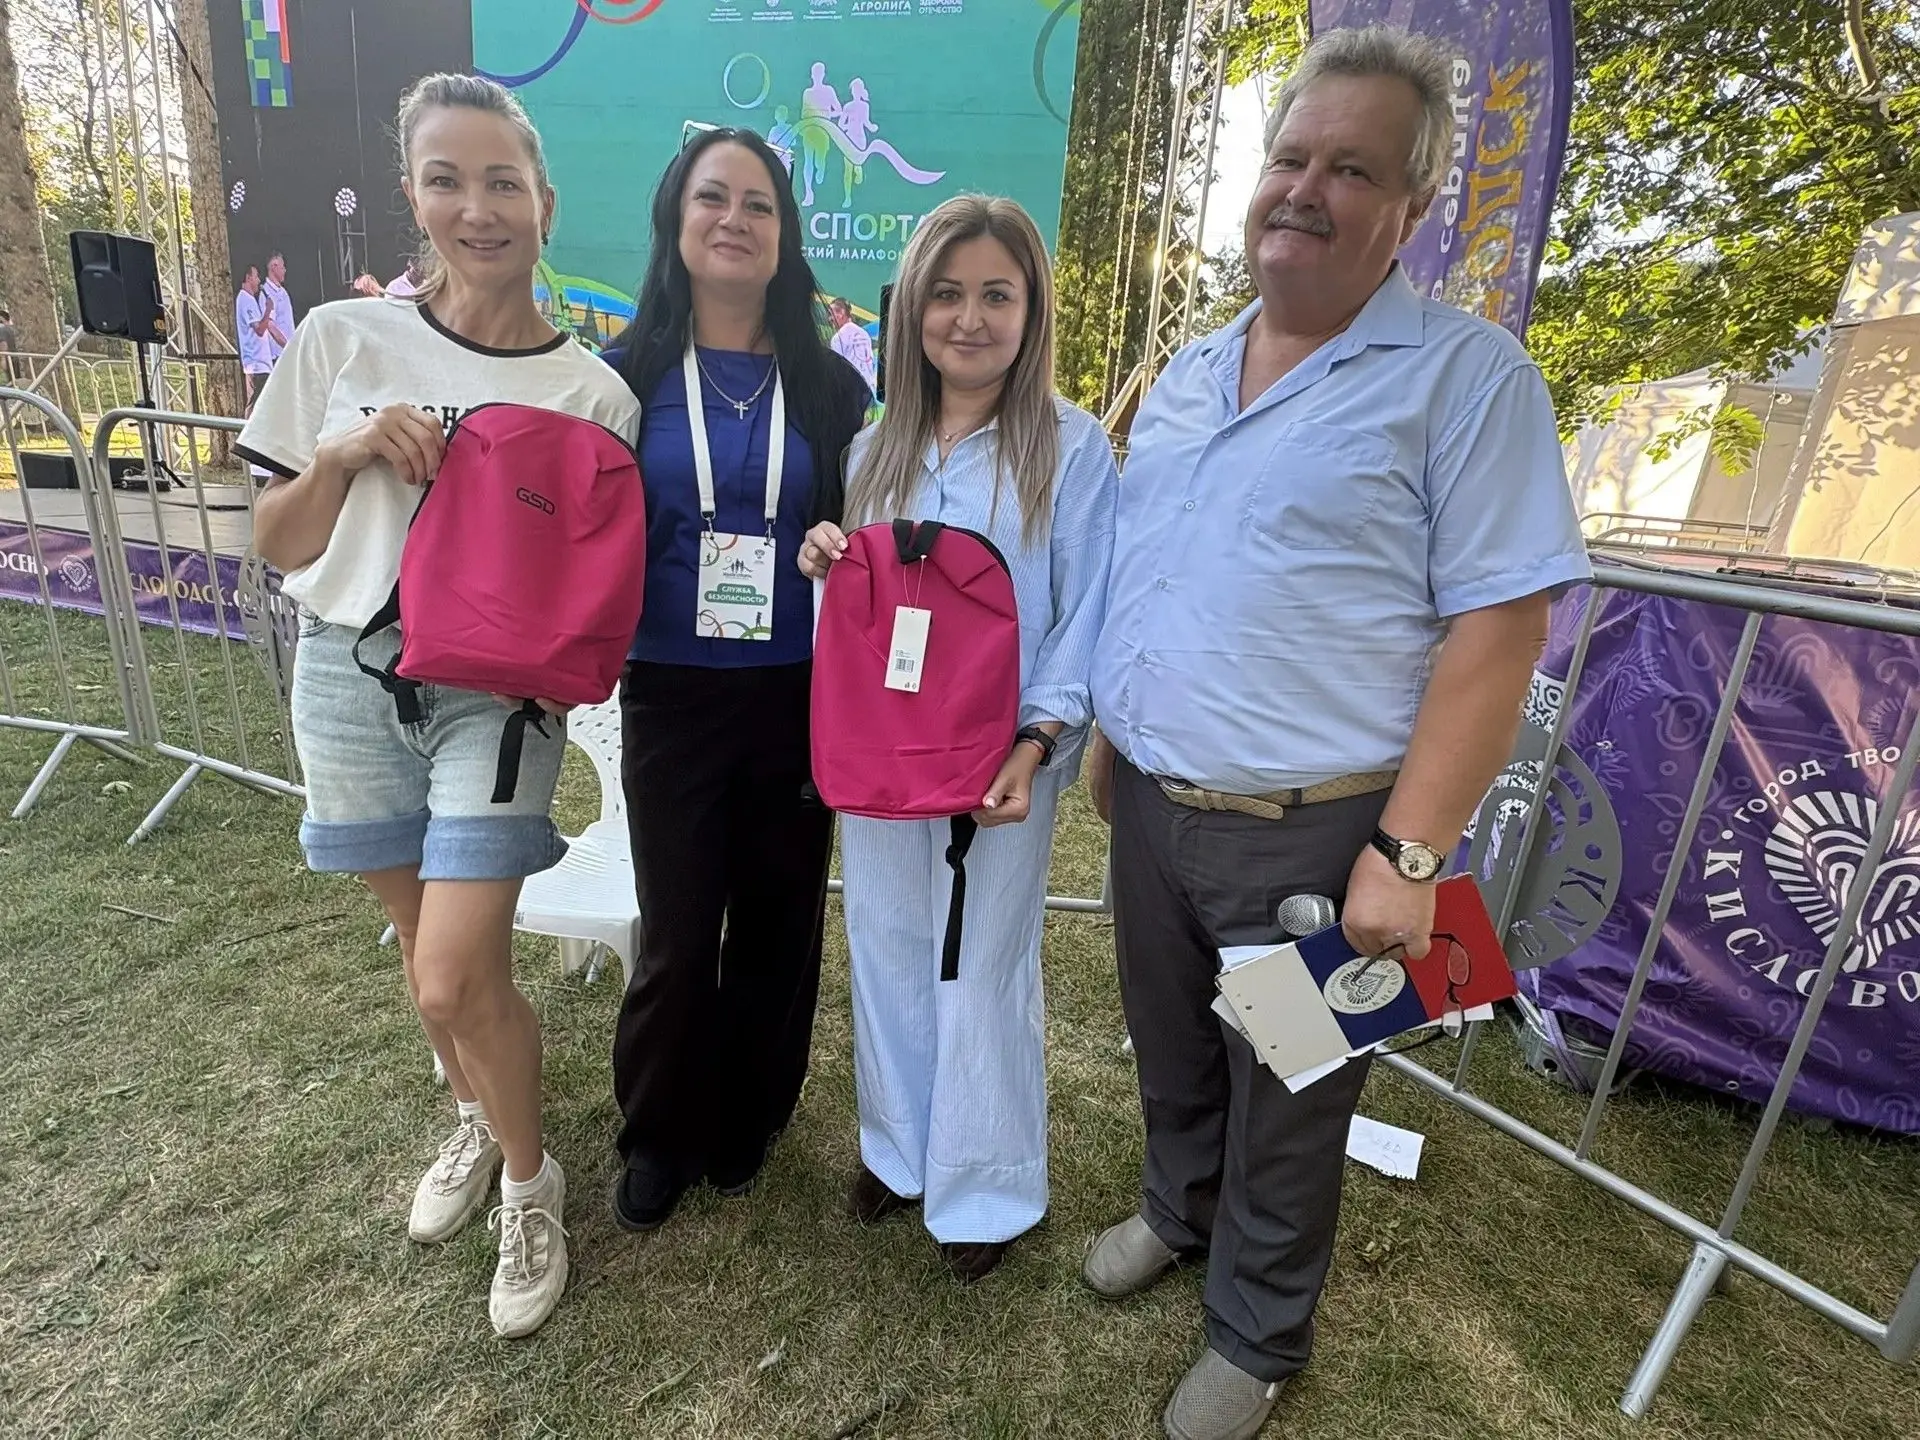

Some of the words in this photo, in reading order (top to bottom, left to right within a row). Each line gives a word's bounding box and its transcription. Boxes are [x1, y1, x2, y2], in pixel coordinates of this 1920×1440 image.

[852, 0, 911, 11] АГРОЛИГА
[839, 248, 902, 260] МАРАФО
[516, 487, 555, 516] GSD
[721, 586, 752, 594] СЛУЖБА
[708, 594, 764, 603] БЕЗОПАСНОСТИ
[1734, 759, 1827, 823] город
[1844, 746, 1901, 769] тво
